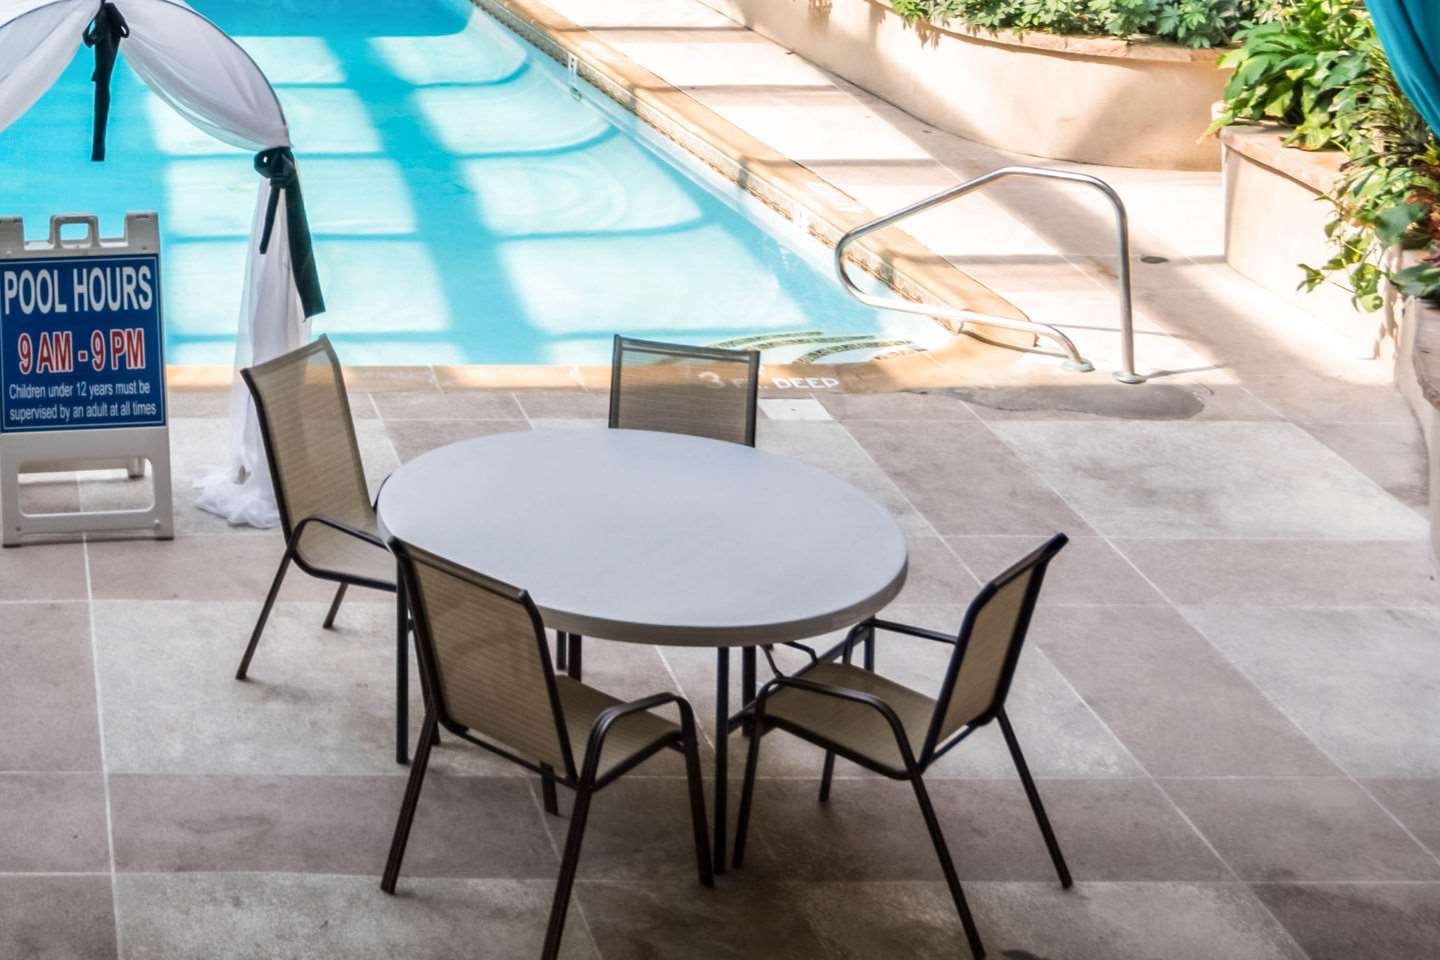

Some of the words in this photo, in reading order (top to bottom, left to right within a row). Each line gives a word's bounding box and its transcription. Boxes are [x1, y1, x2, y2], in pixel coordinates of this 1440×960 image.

[4, 269, 67, 315] POOL
[73, 265, 153, 312] HOURS
[18, 333, 33, 375] 9
[36, 331, 74, 374] AM
[78, 350, 88, 362] -
[90, 329, 106, 371] 9
[110, 328, 146, 370] PM
[9, 383, 46, 400] Children
[48, 384, 73, 397] under
[76, 381, 87, 396] 12
[89, 384, 113, 400] years
[115, 381, 137, 395] must
[138, 379, 150, 394] be
[771, 377, 839, 389] DEEP
[10, 404, 58, 423] supervised
[59, 404, 71, 422] by
[72, 406, 84, 417] an
[86, 403, 108, 417] adult
[110, 402, 119, 416] at
[120, 401, 131, 415] all
[132, 401, 157, 415] times
